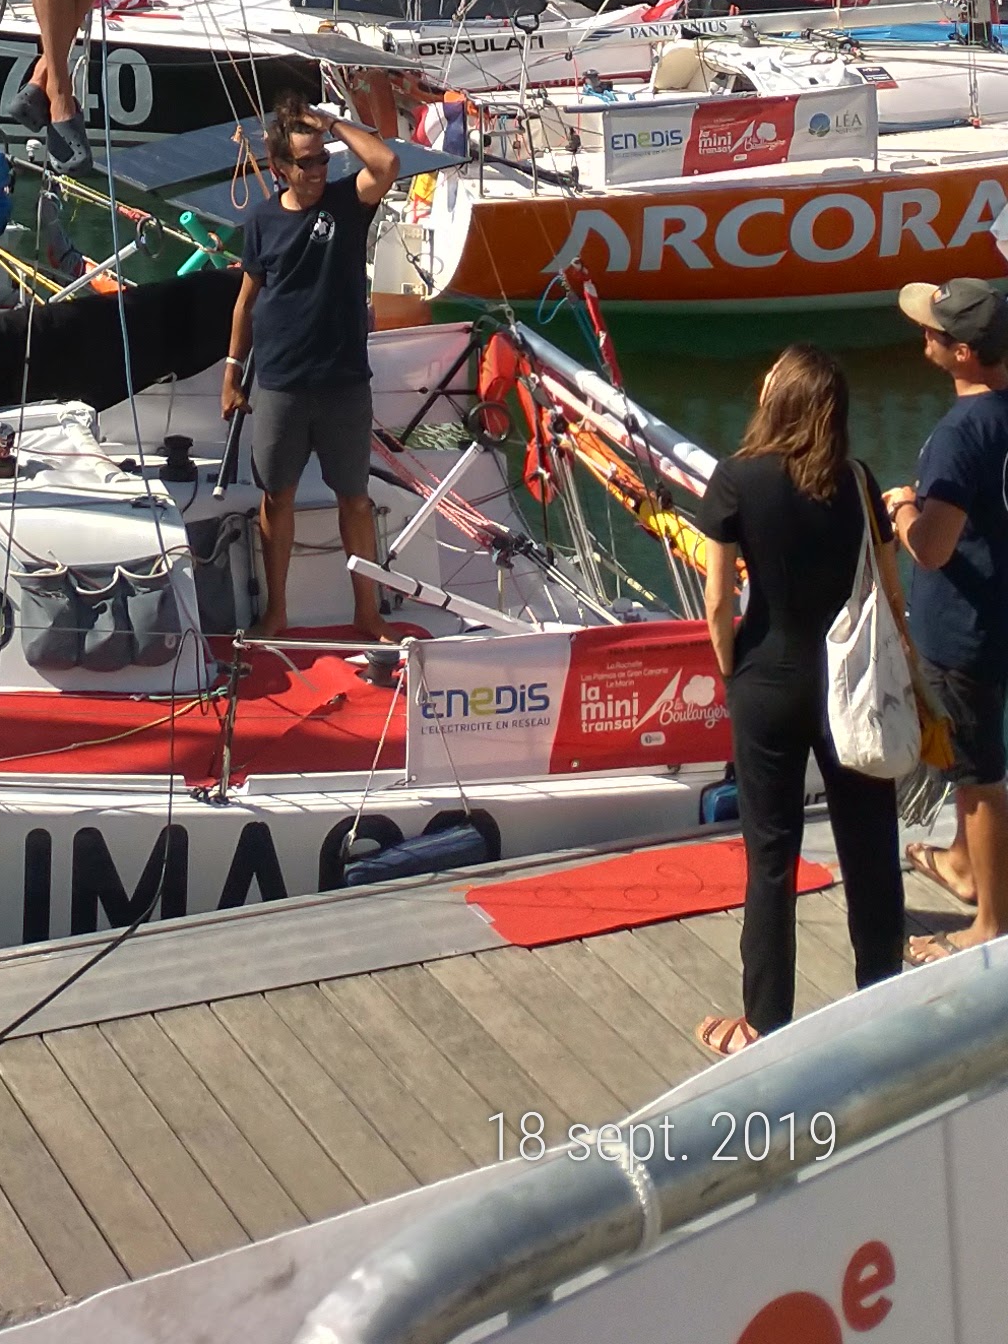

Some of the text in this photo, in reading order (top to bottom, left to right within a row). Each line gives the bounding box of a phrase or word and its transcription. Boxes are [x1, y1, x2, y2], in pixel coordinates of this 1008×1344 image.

[417, 34, 545, 57] OSCULATI
[698, 133, 733, 149] mini
[580, 682, 600, 702] la
[580, 691, 639, 721] mini
[659, 697, 730, 730] Boulangèr
[495, 719, 509, 731] EN
[511, 716, 551, 729] RESEAU
[581, 715, 639, 733] transat
